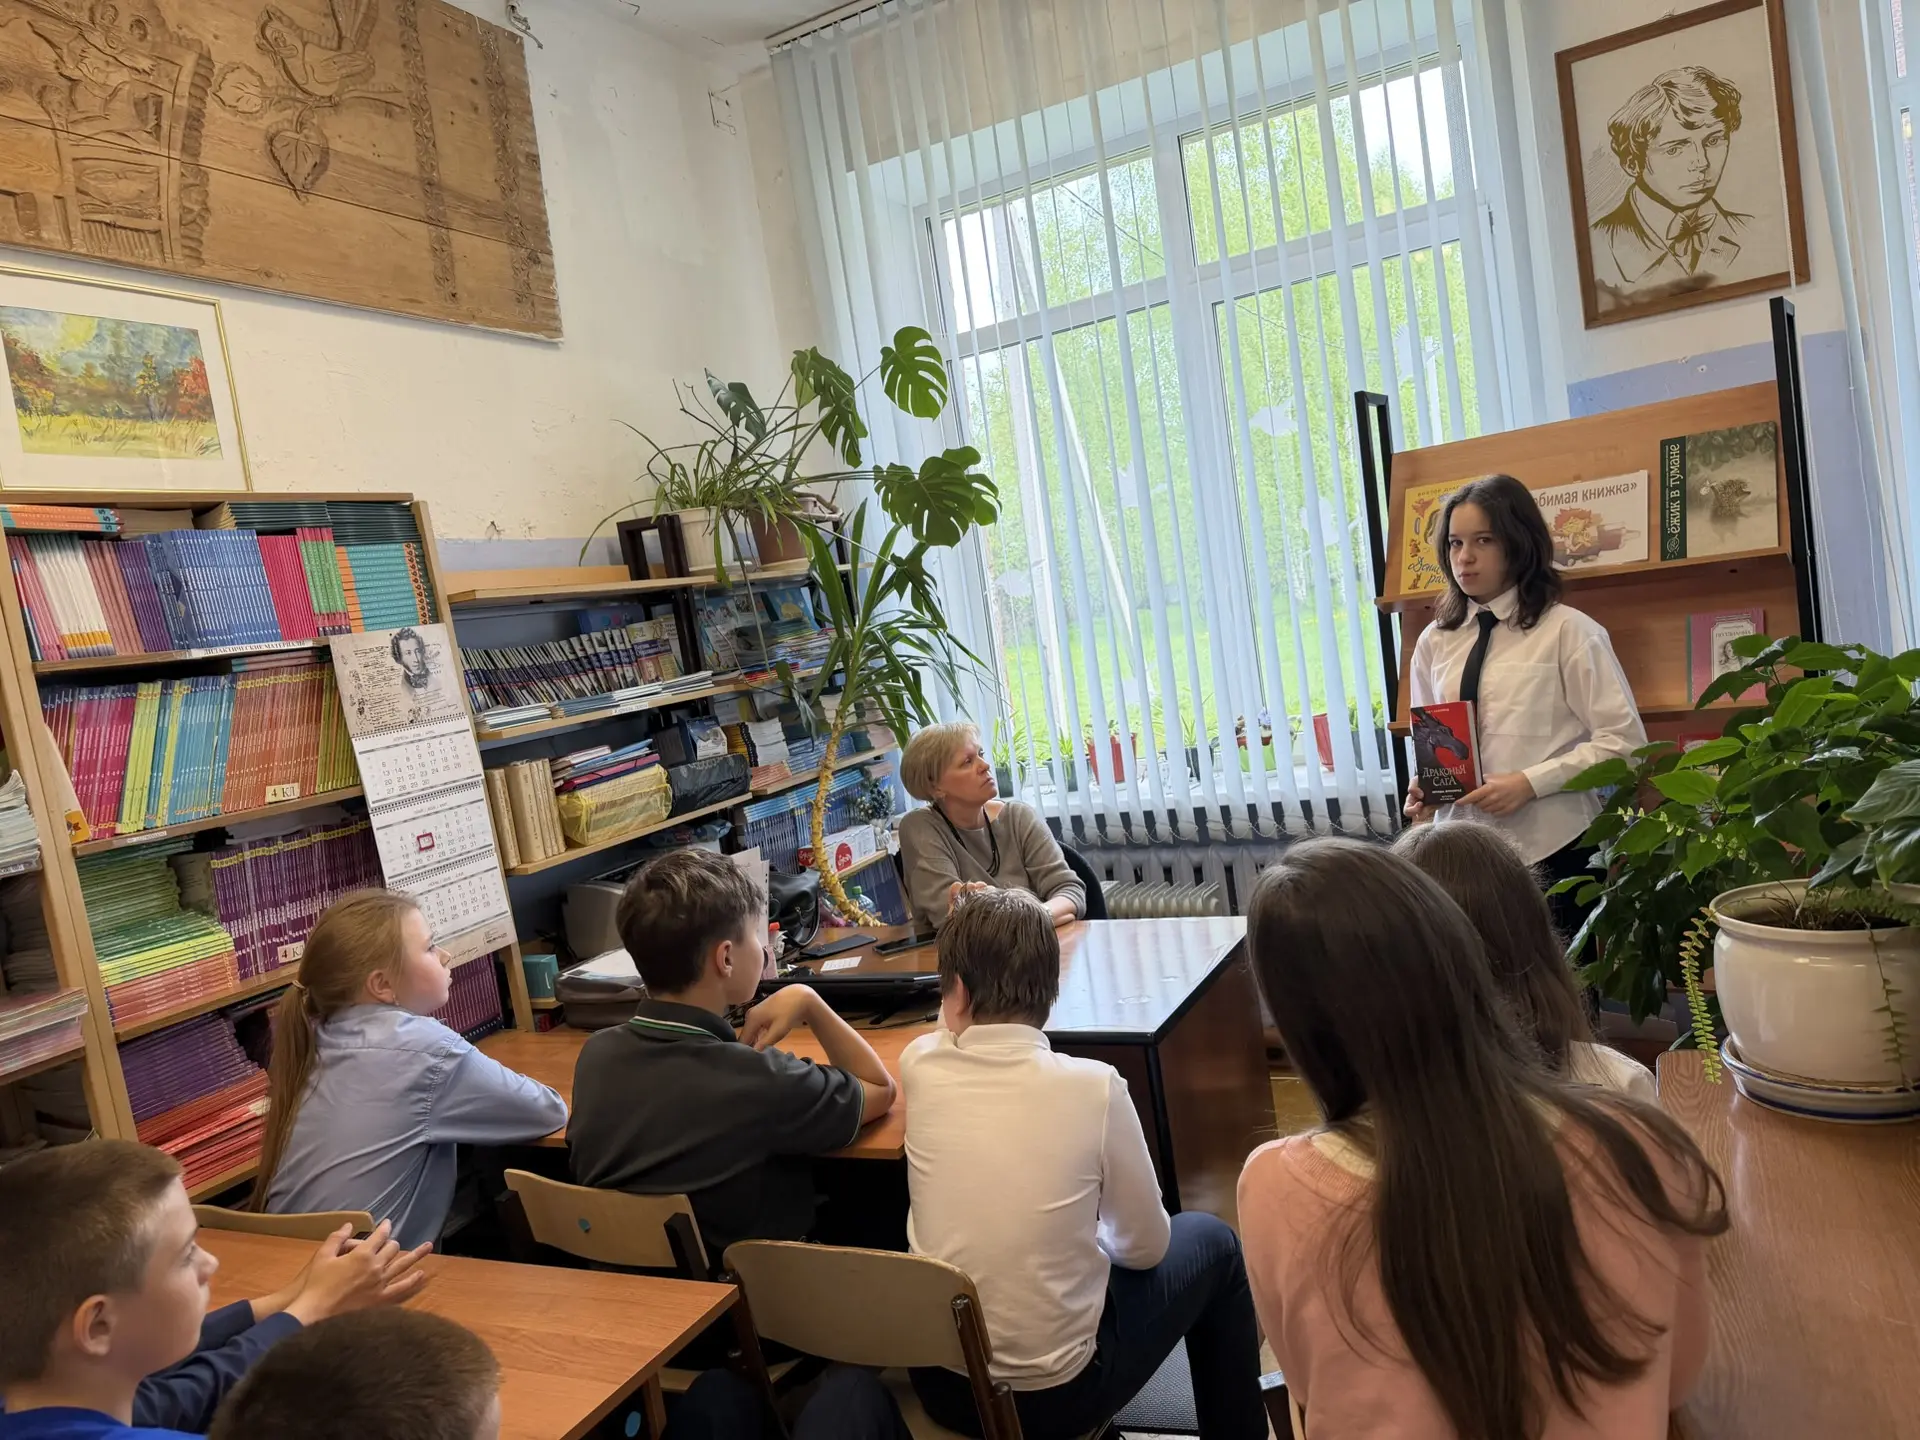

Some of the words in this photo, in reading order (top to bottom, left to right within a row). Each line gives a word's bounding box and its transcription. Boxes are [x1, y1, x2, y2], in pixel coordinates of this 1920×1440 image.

[1670, 443, 1684, 487] тумане
[1582, 481, 1637, 502] книжка»
[1408, 556, 1441, 573] Дени
[1424, 572, 1448, 589] рас
[1423, 764, 1466, 778] ДРАКОНЬЯ
[271, 788, 277, 797] 4
[281, 949, 288, 958] 4
